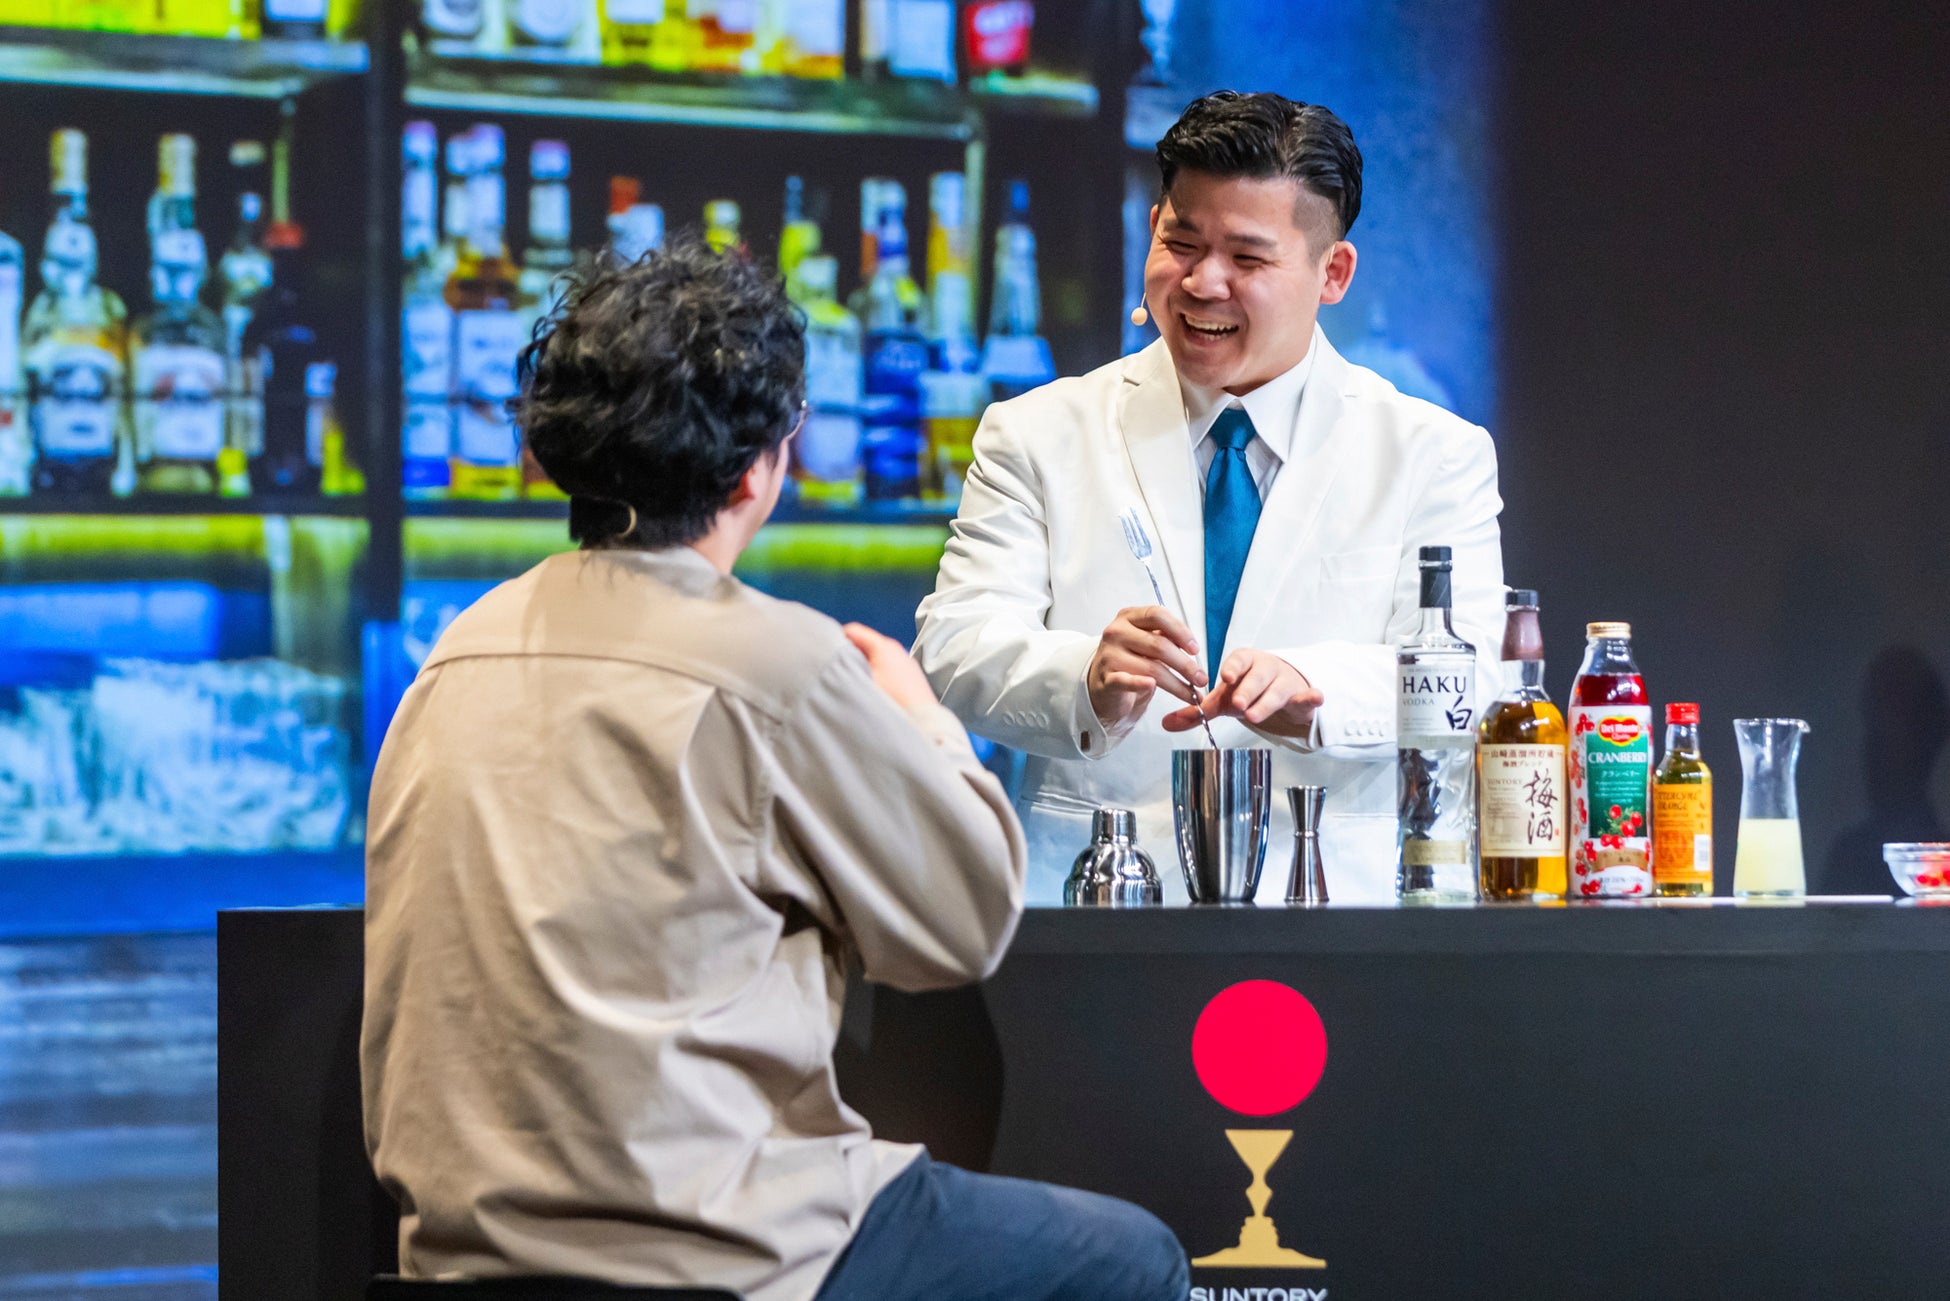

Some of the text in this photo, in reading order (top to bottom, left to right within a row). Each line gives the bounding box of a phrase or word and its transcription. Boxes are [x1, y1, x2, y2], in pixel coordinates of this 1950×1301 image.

[1402, 675, 1467, 694] HAKU
[1402, 698, 1435, 706] VODKA
[1445, 695, 1473, 731] 白
[1522, 768, 1559, 846] 梅酒
[1189, 1287, 1329, 1301] SUNTORY
